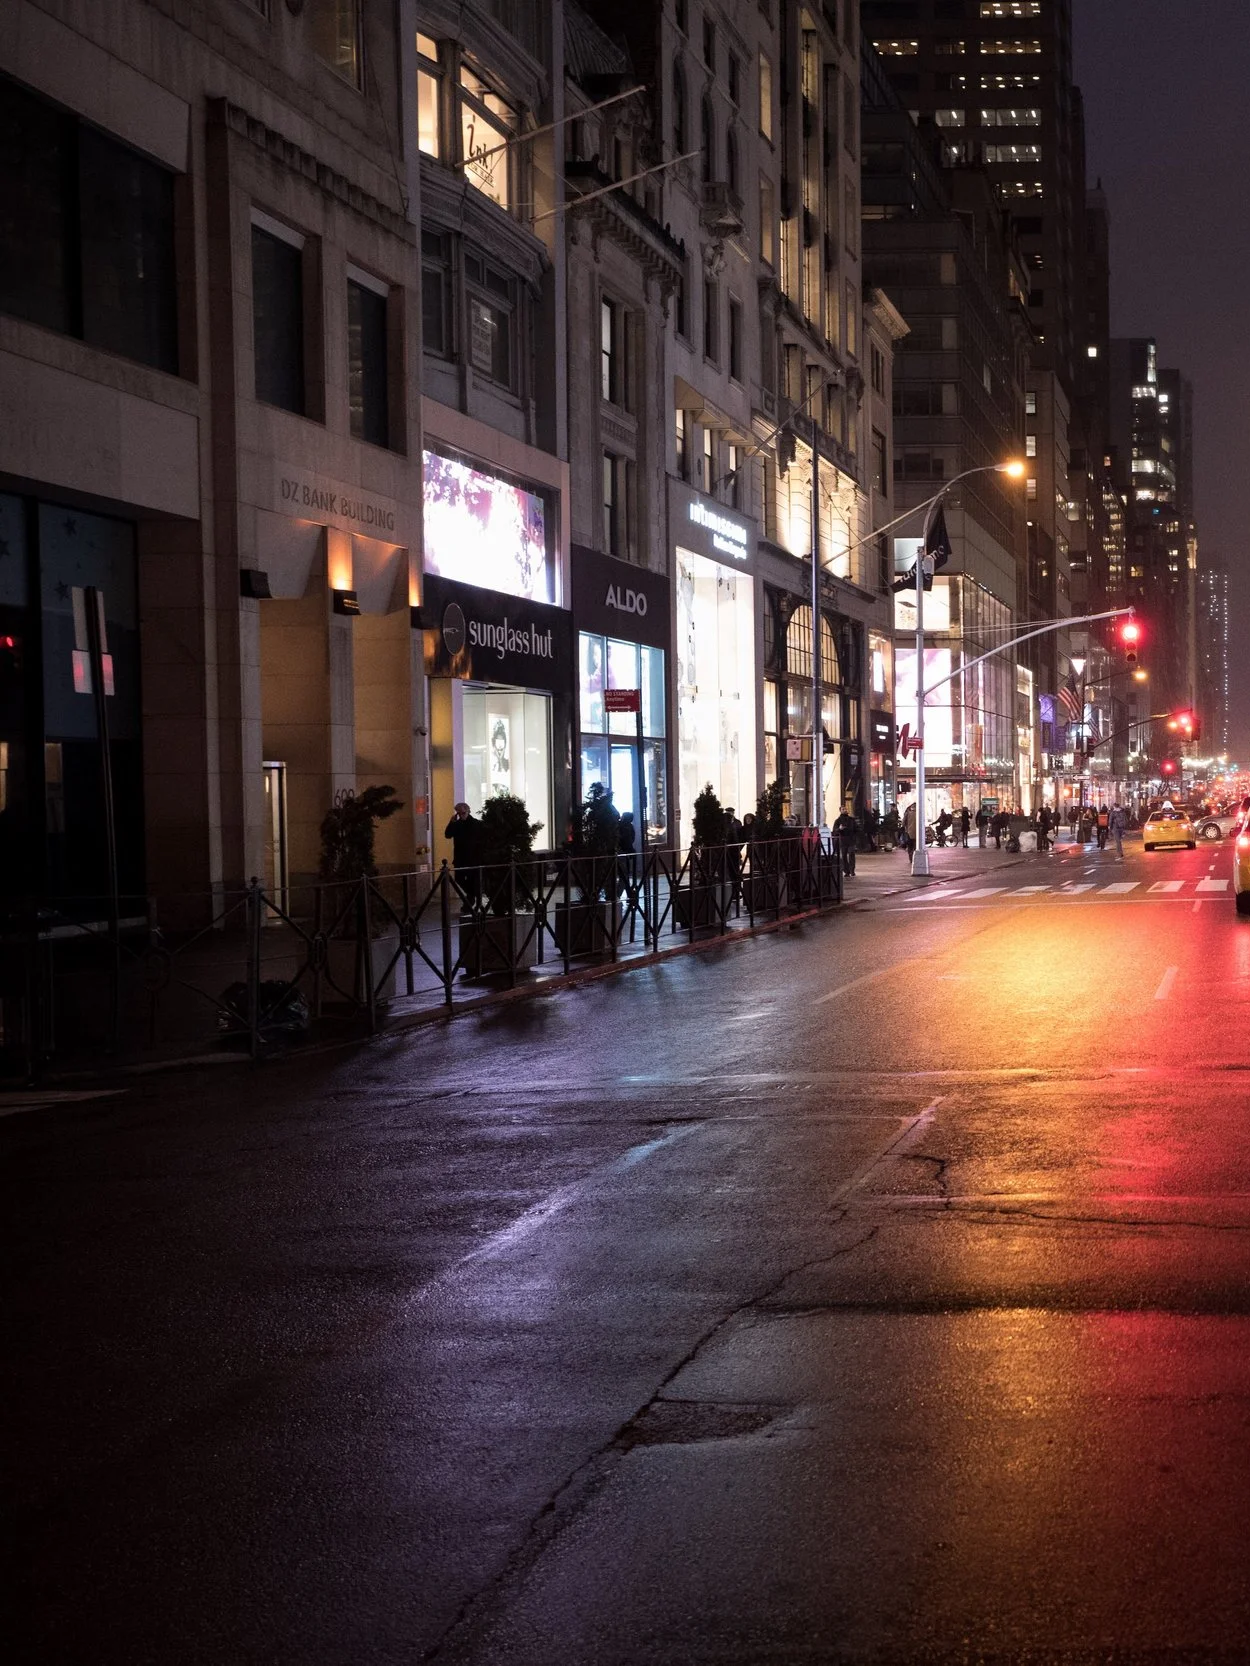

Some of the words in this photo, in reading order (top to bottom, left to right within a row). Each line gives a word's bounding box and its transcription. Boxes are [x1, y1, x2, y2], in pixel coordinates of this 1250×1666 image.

[281, 479, 299, 502] DZ
[302, 484, 338, 515] BANK
[340, 497, 395, 531] BUILDING
[605, 583, 648, 617] ALDO
[469, 616, 530, 660] sunglass
[532, 623, 553, 659] hut
